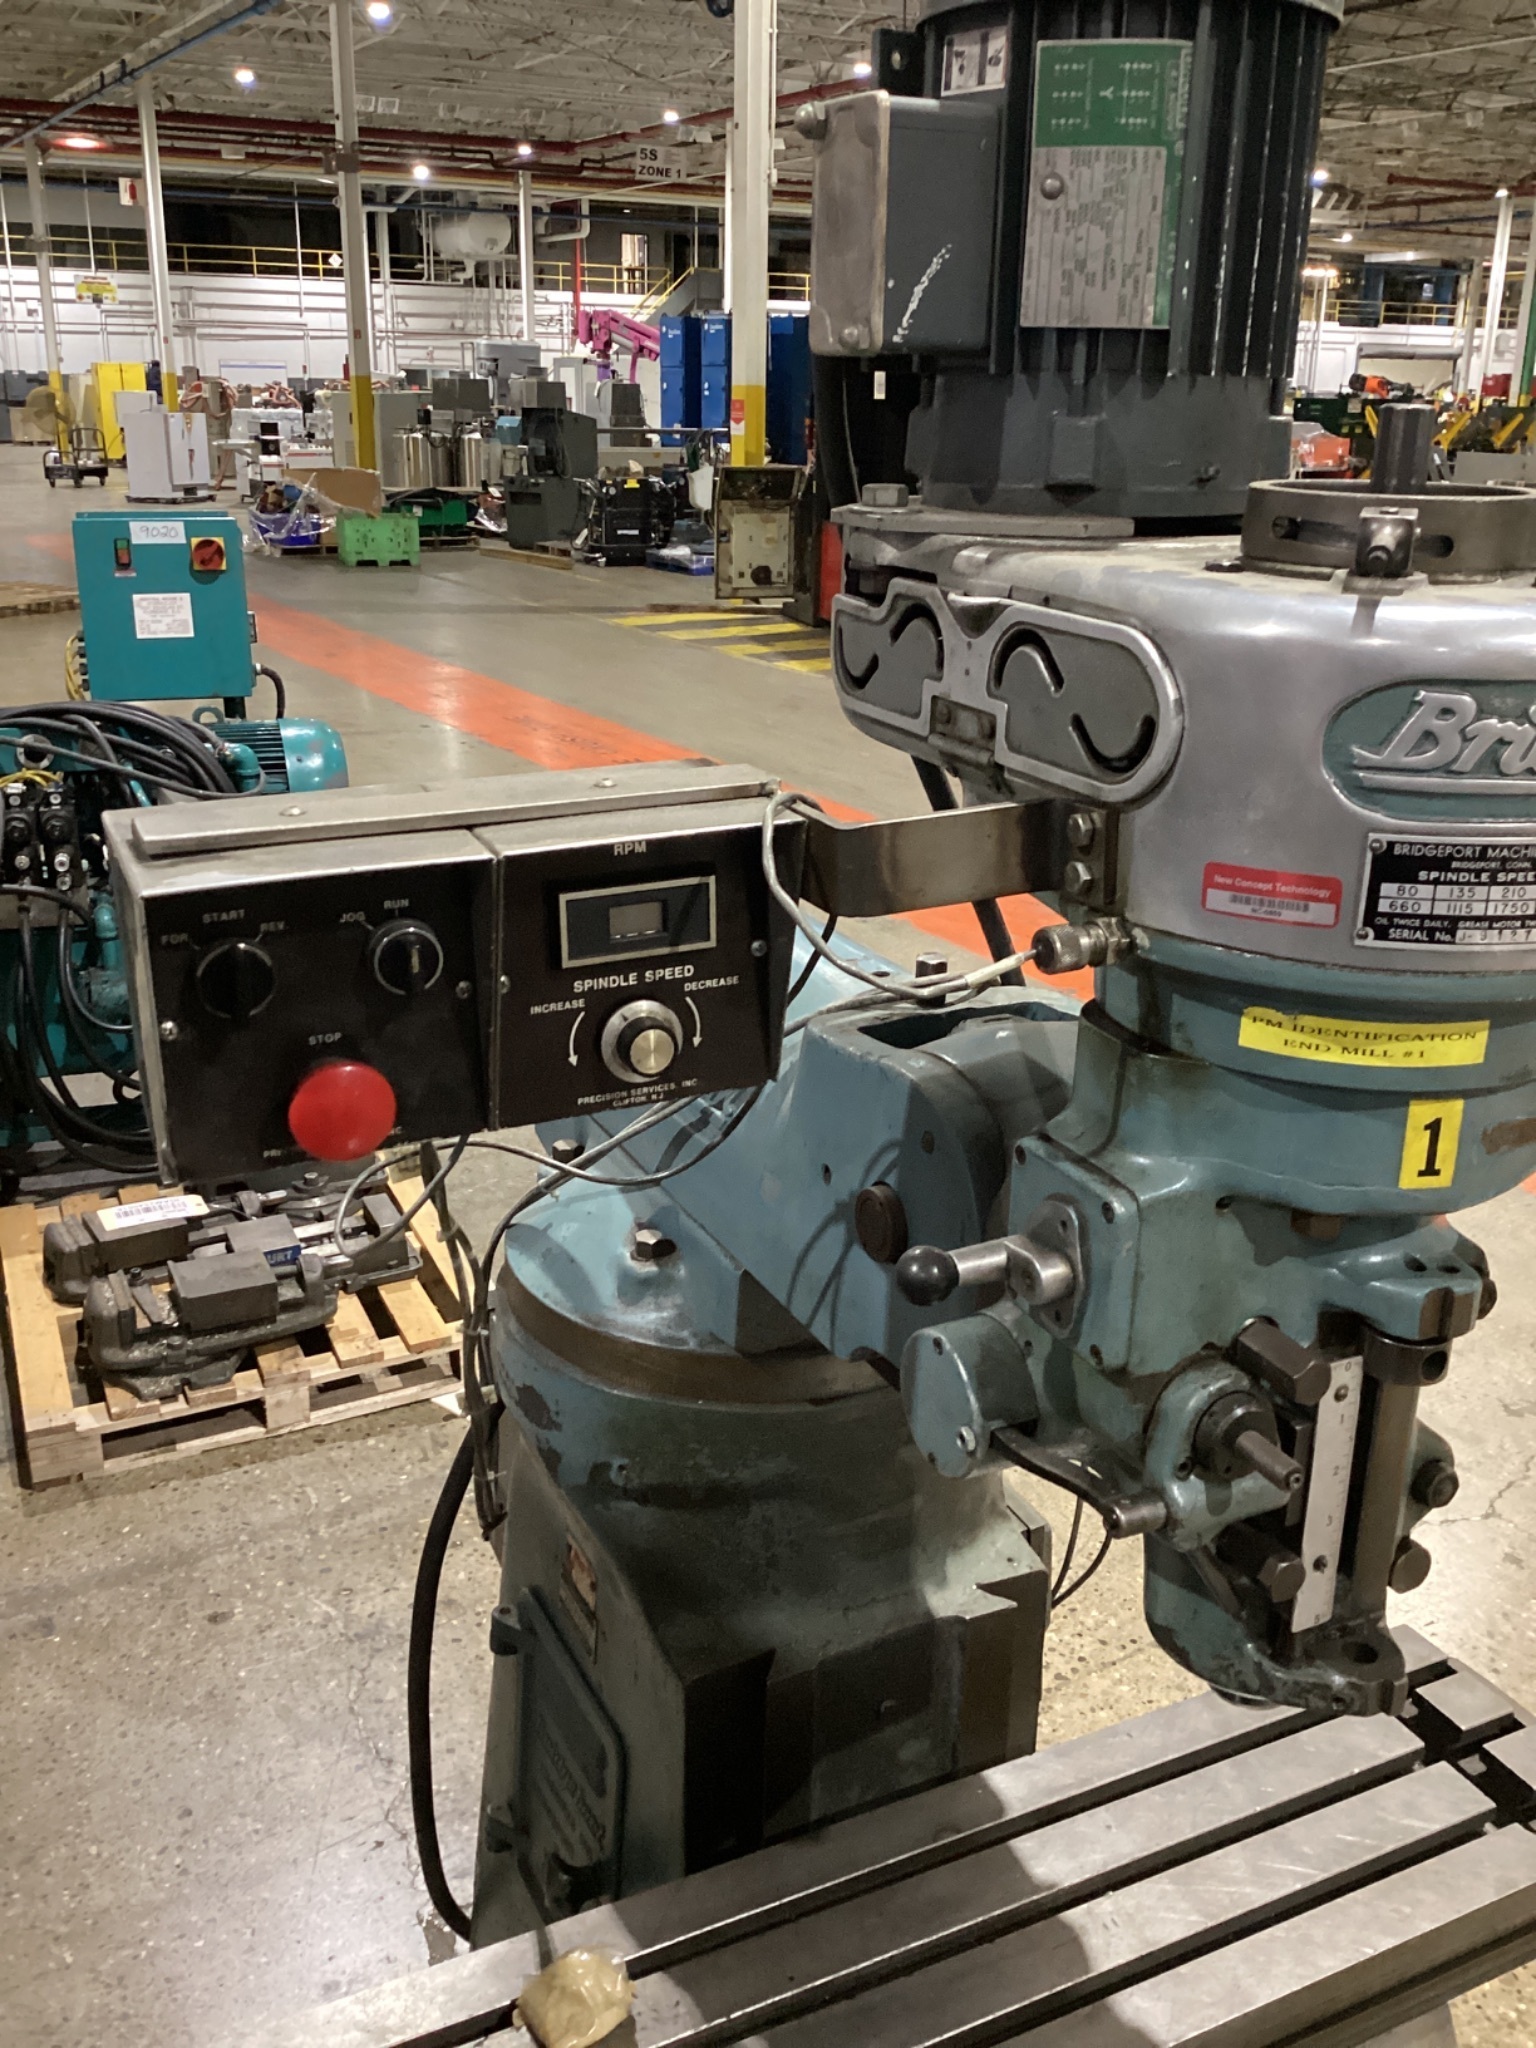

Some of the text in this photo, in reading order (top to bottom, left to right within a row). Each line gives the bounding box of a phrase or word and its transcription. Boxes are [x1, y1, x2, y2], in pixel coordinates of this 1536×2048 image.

[639, 148, 657, 161] 5S
[639, 165, 681, 178] ZONE 1
[140, 525, 179, 538] 9020
[613, 841, 647, 856] RPM
[1393, 843, 1482, 858] BRIDGEPORT
[1418, 870, 1491, 882] SPINDLE
[1214, 874, 1332, 898] New Concept Technology
[1397, 885, 1527, 898] 80 135 210
[384, 898, 410, 909] RUN
[1388, 900, 1530, 914] 660 1115 1750
[202, 909, 245, 923] START
[339, 911, 366, 923] JOG
[1374, 916, 1389, 925] OIL
[1393, 918, 1420, 927] TWICE
[1457, 920, 1489, 928] GREASE
[1492, 920, 1522, 928] MOTOR
[161, 933, 188, 945] FOR
[1388, 928, 1429, 941] SERIAL
[1434, 931, 1454, 942] No.
[573, 964, 695, 993] SPINDLE SPEED
[684, 975, 740, 992] DECREASE
[530, 999, 586, 1015] INCREASE
[308, 1031, 343, 1046] STOP
[1292, 1022, 1477, 1043] IDENTIFICATION
[1283, 1038, 1332, 1053] END
[1341, 1046, 1393, 1059] MILL
[577, 1090, 628, 1106] PRECISION
[1416, 1116, 1443, 1178] 1
